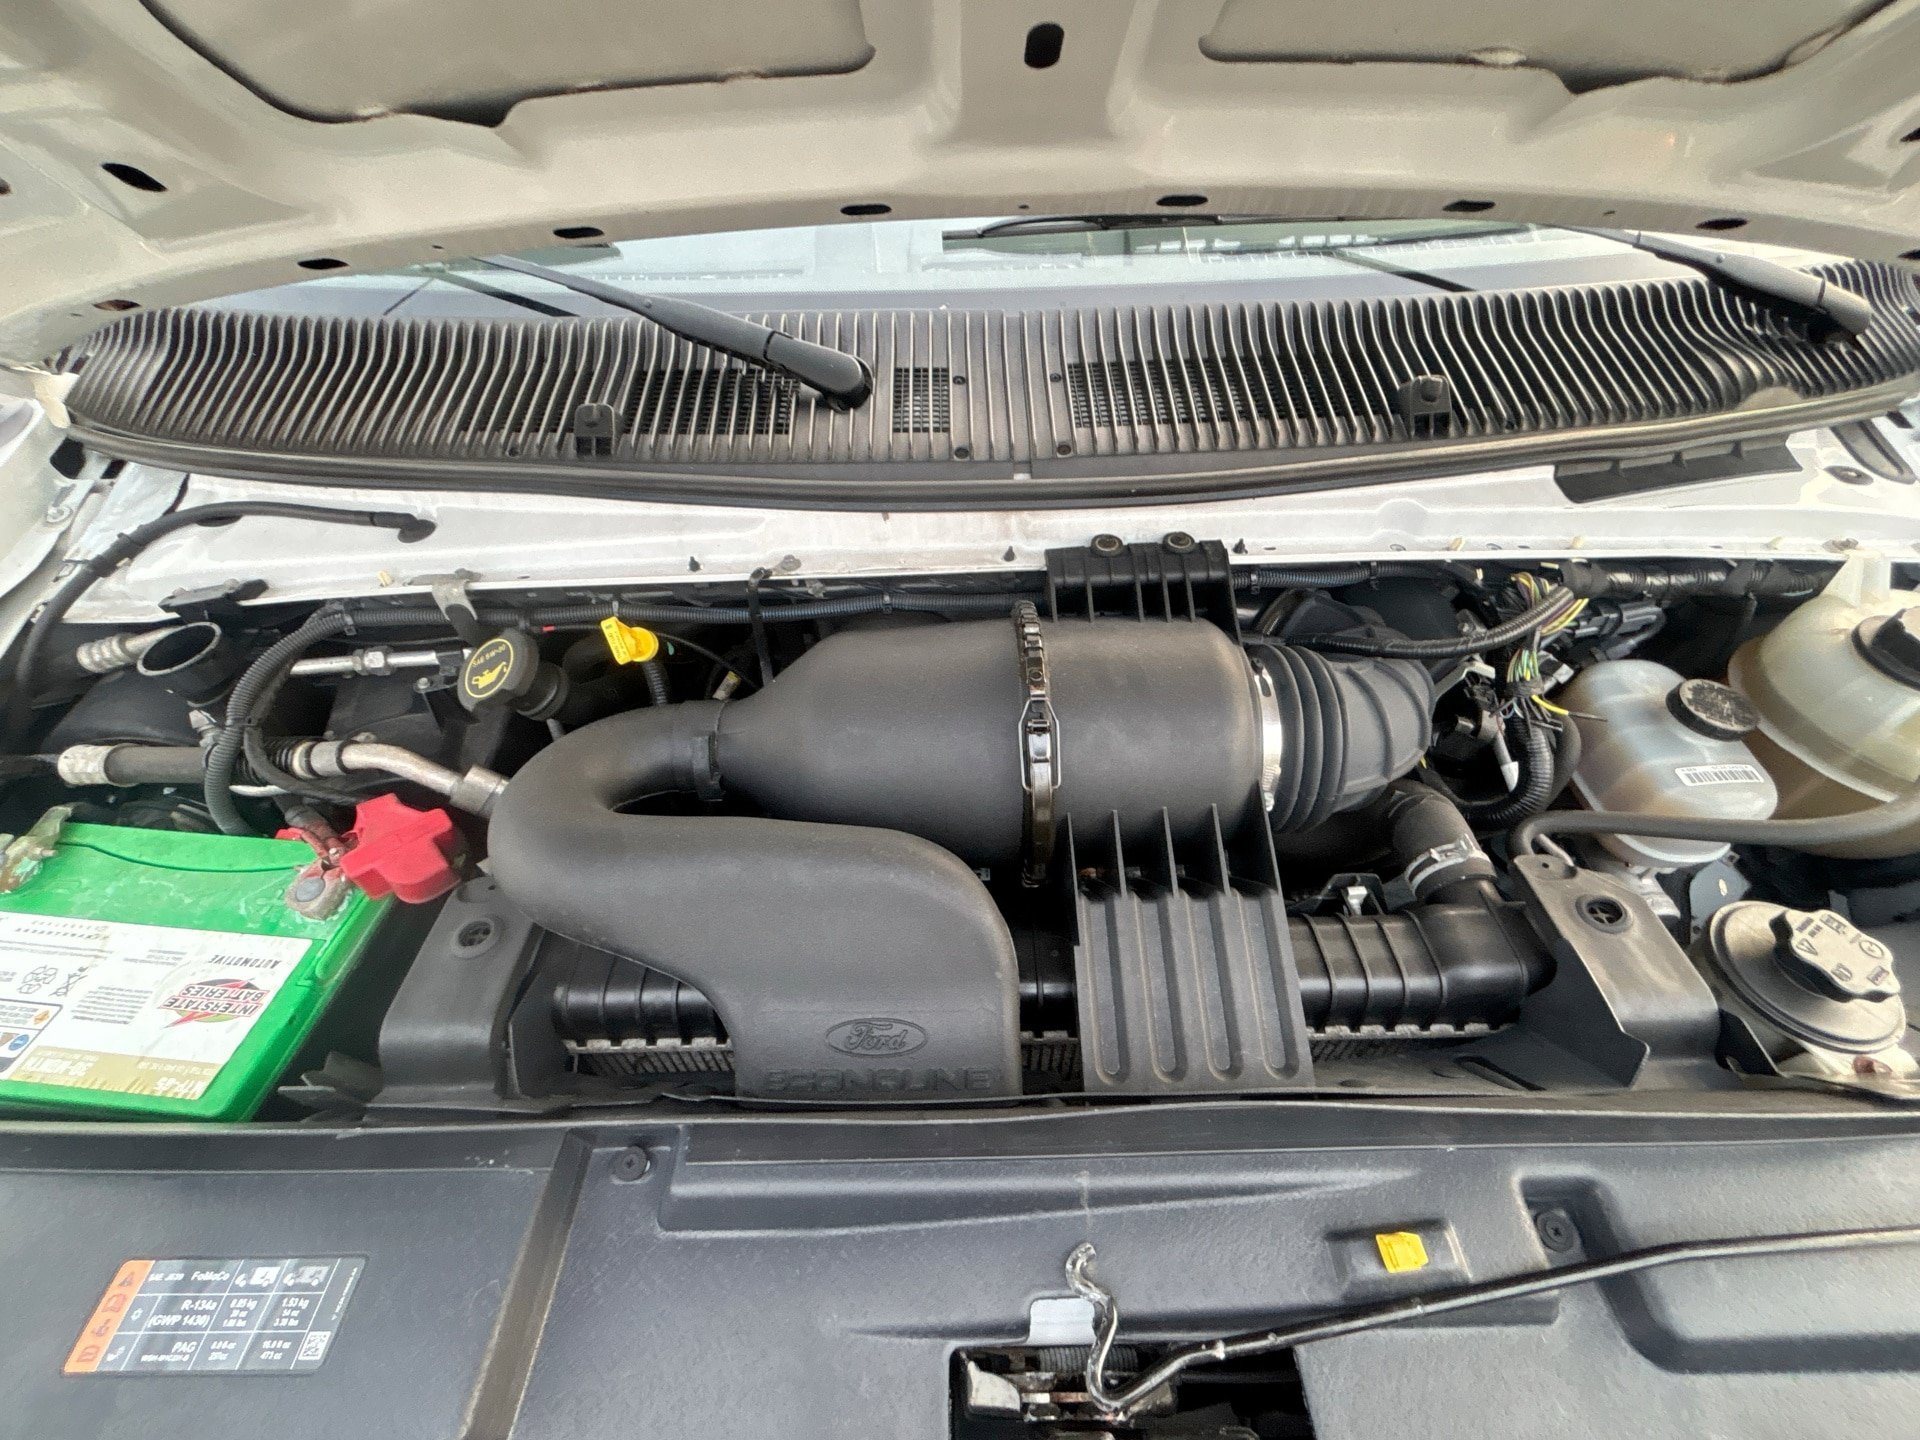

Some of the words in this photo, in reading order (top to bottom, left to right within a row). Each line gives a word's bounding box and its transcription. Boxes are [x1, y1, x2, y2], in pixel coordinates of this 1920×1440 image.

[207, 954, 282, 969] AUTOMOTIVE
[181, 985, 264, 1002] BATTERIES
[162, 996, 259, 1015] INTERSTATE
[845, 1020, 908, 1051] Ford
[190, 1270, 230, 1281] FoMoCo
[180, 1299, 218, 1311] R-134a
[147, 1314, 181, 1328] (GWP
[171, 1341, 198, 1353] PAG
